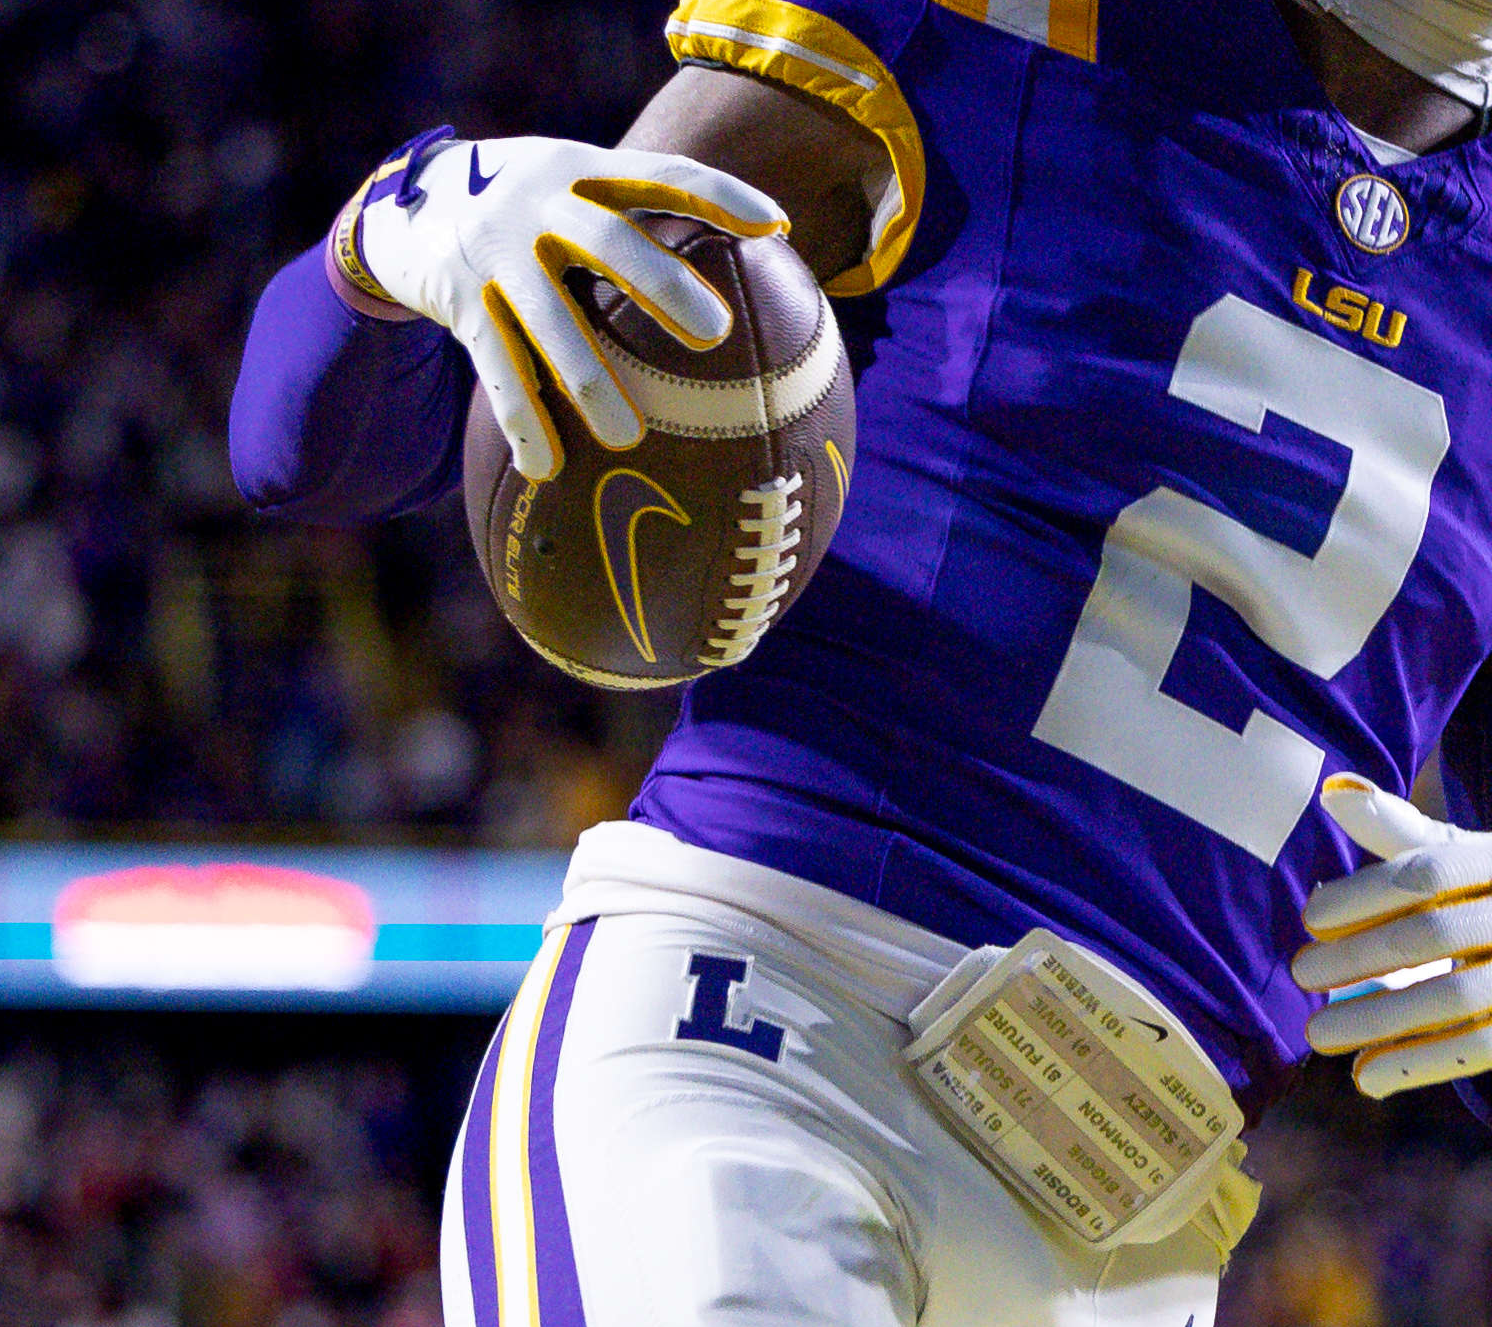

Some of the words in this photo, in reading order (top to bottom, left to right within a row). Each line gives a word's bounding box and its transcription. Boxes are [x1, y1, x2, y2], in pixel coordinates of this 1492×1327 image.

[1342, 179, 1404, 248] SEC
[1292, 266, 1408, 349] LSU
[1031, 292, 1450, 866] 2
[676, 953, 784, 1063] L
[984, 1005, 1045, 1067] FUTURE
[1160, 1070, 1208, 1119] CHIEF
[1078, 1099, 1149, 1172] COMMON
[1033, 1161, 1090, 1220] BOOSIE
